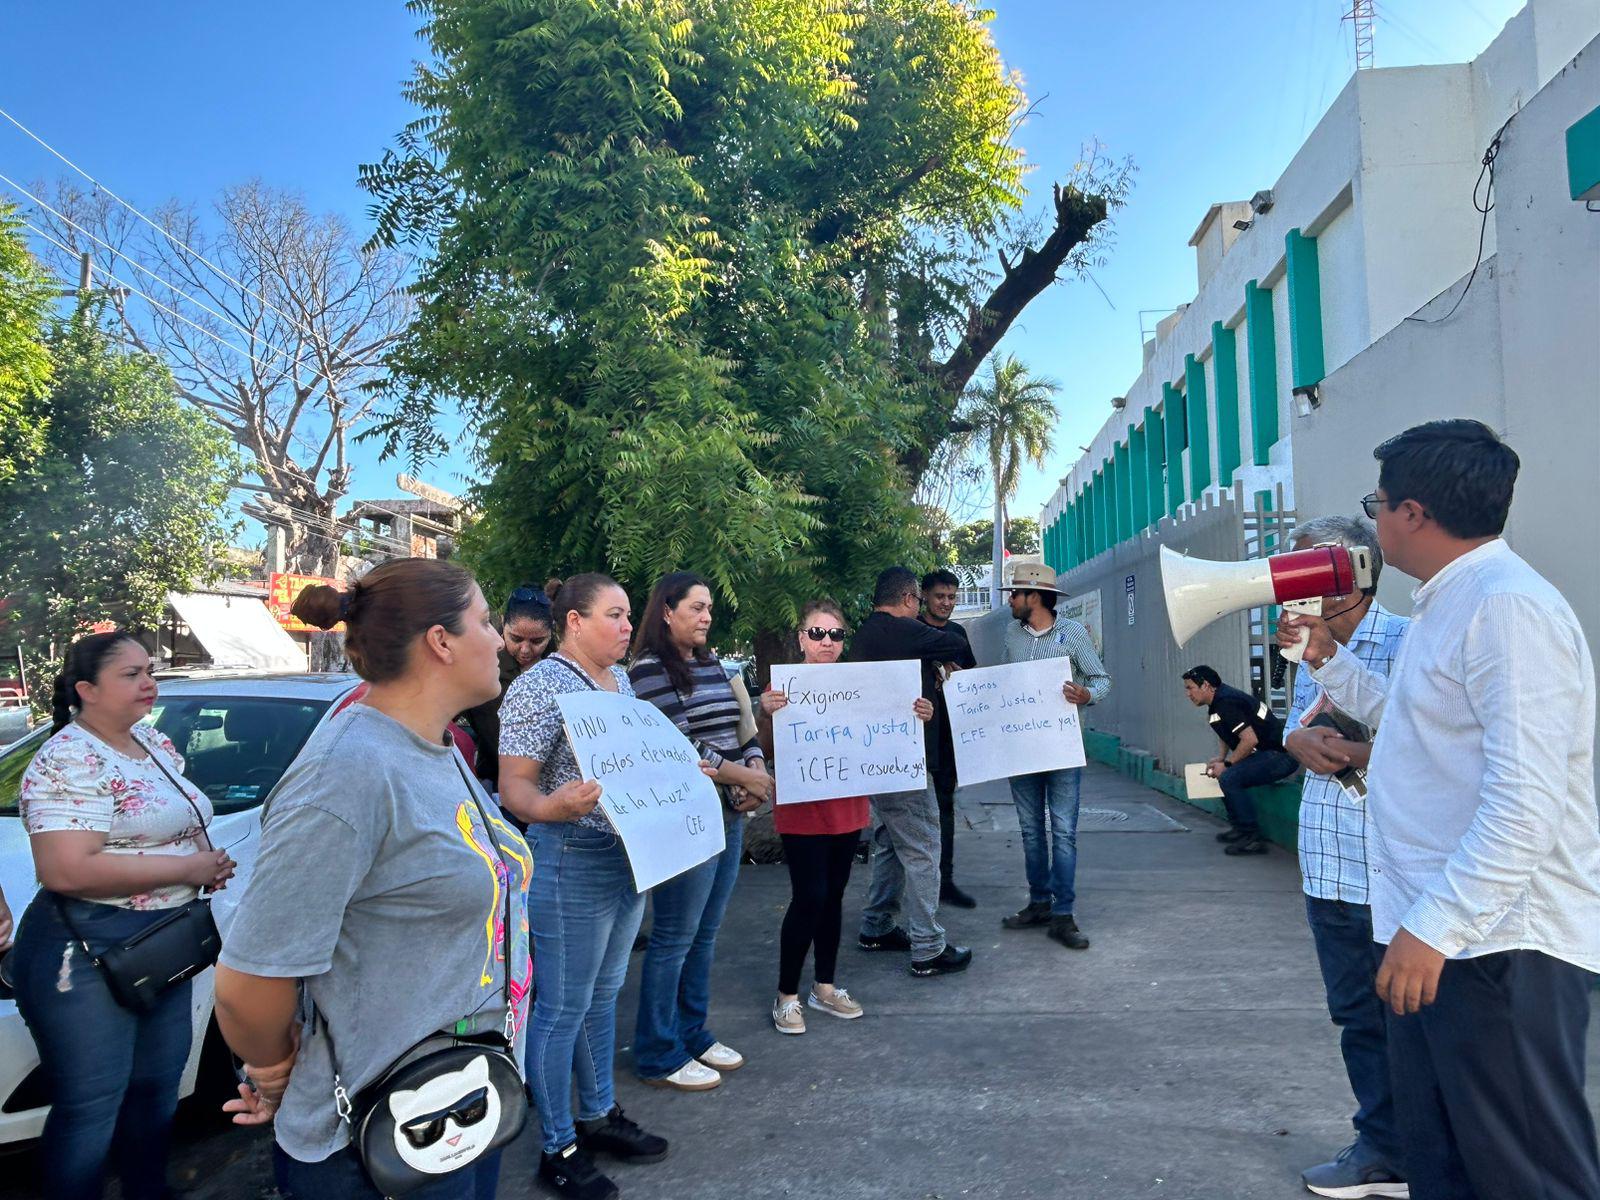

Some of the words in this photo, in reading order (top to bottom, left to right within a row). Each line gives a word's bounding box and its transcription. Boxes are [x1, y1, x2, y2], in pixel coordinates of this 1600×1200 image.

[621, 714, 632, 727] a
[633, 708, 660, 727] los
[957, 702, 991, 715] Tarifa
[788, 721, 852, 744] Tarifa
[863, 716, 918, 747] justa!
[960, 728, 987, 744] CFE
[1000, 717, 1053, 733] resuelve
[1058, 714, 1078, 731] ya!
[591, 751, 634, 780] Costos
[641, 741, 692, 764] elevados
[797, 757, 849, 782] ¡CFE
[860, 757, 908, 776] resuelve
[910, 757, 926, 779] ya!
[607, 793, 629, 815] de
[626, 792, 648, 809] la
[685, 815, 705, 836] CFE
